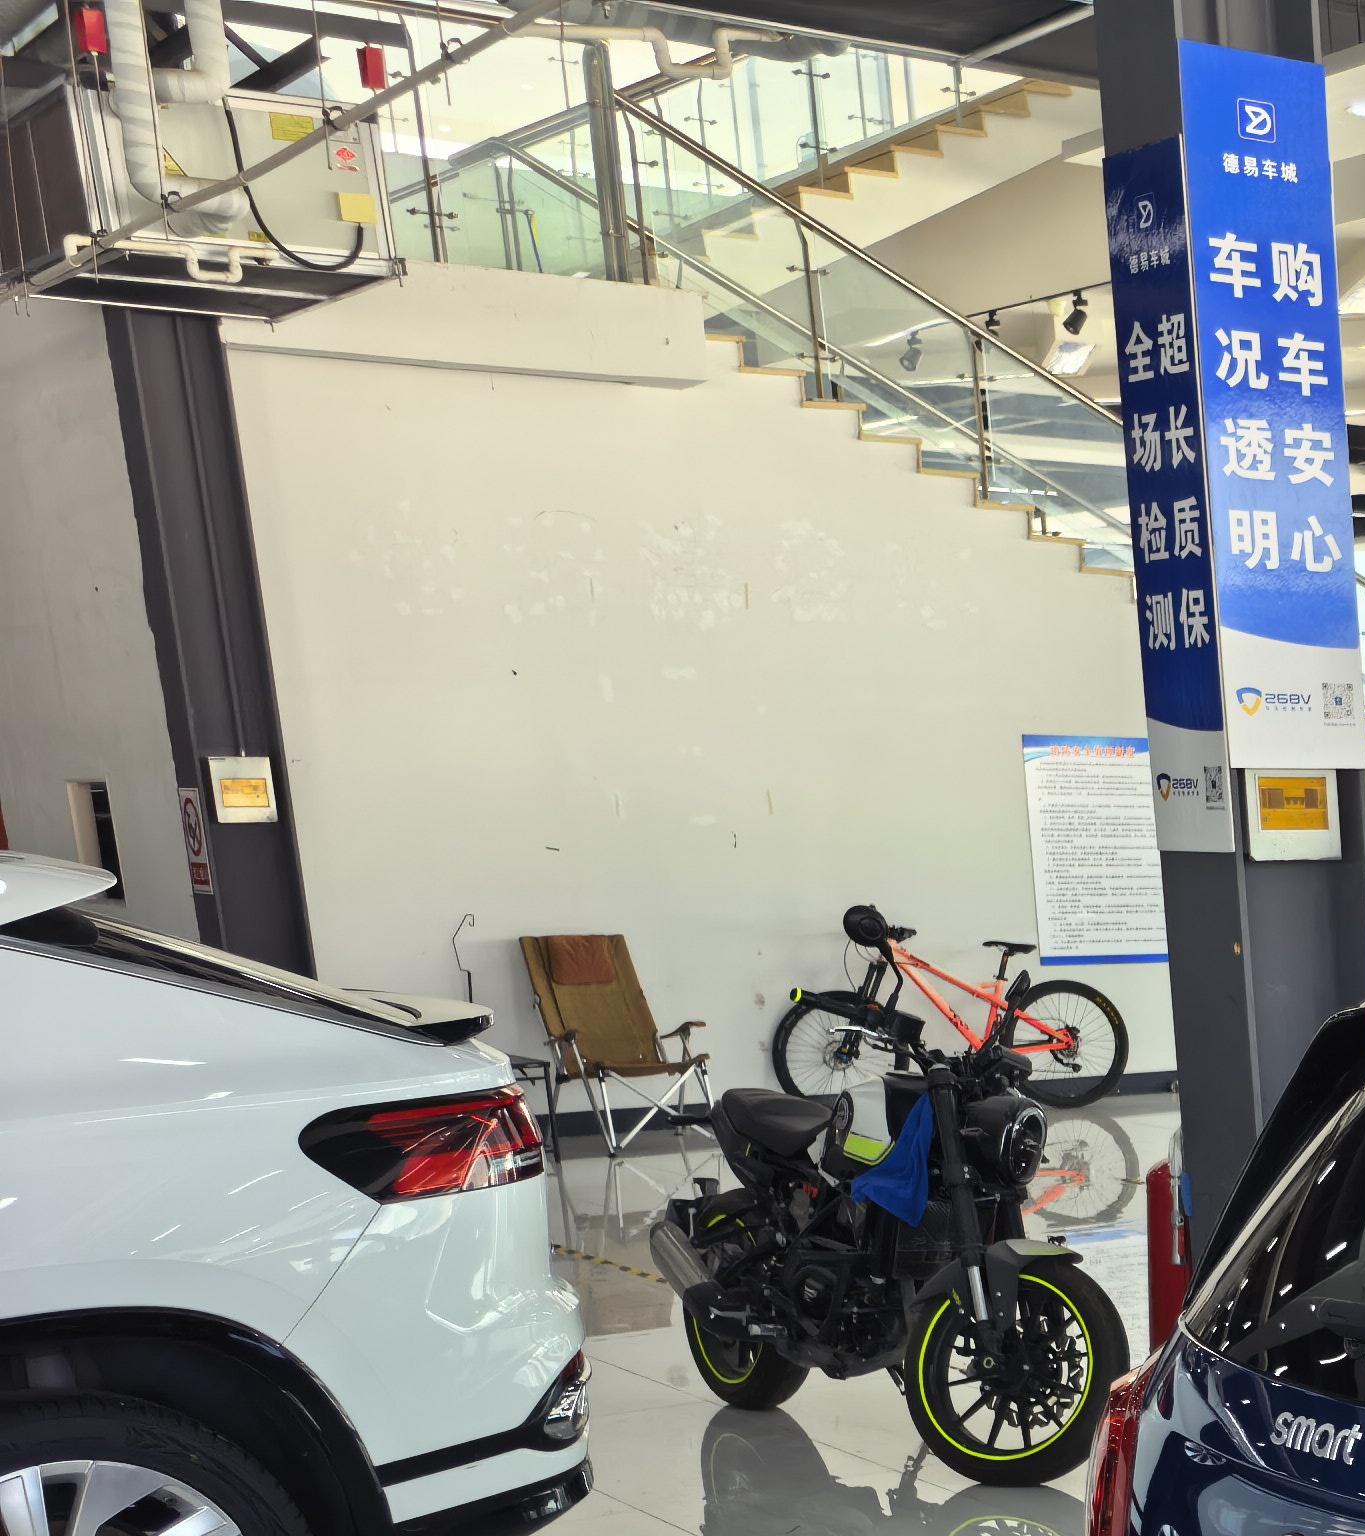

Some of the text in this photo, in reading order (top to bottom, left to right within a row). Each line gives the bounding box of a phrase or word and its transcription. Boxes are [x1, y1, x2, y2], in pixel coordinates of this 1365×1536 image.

[1222, 153, 1299, 184] 德易车城
[1270, 1411, 1363, 1466] smart
